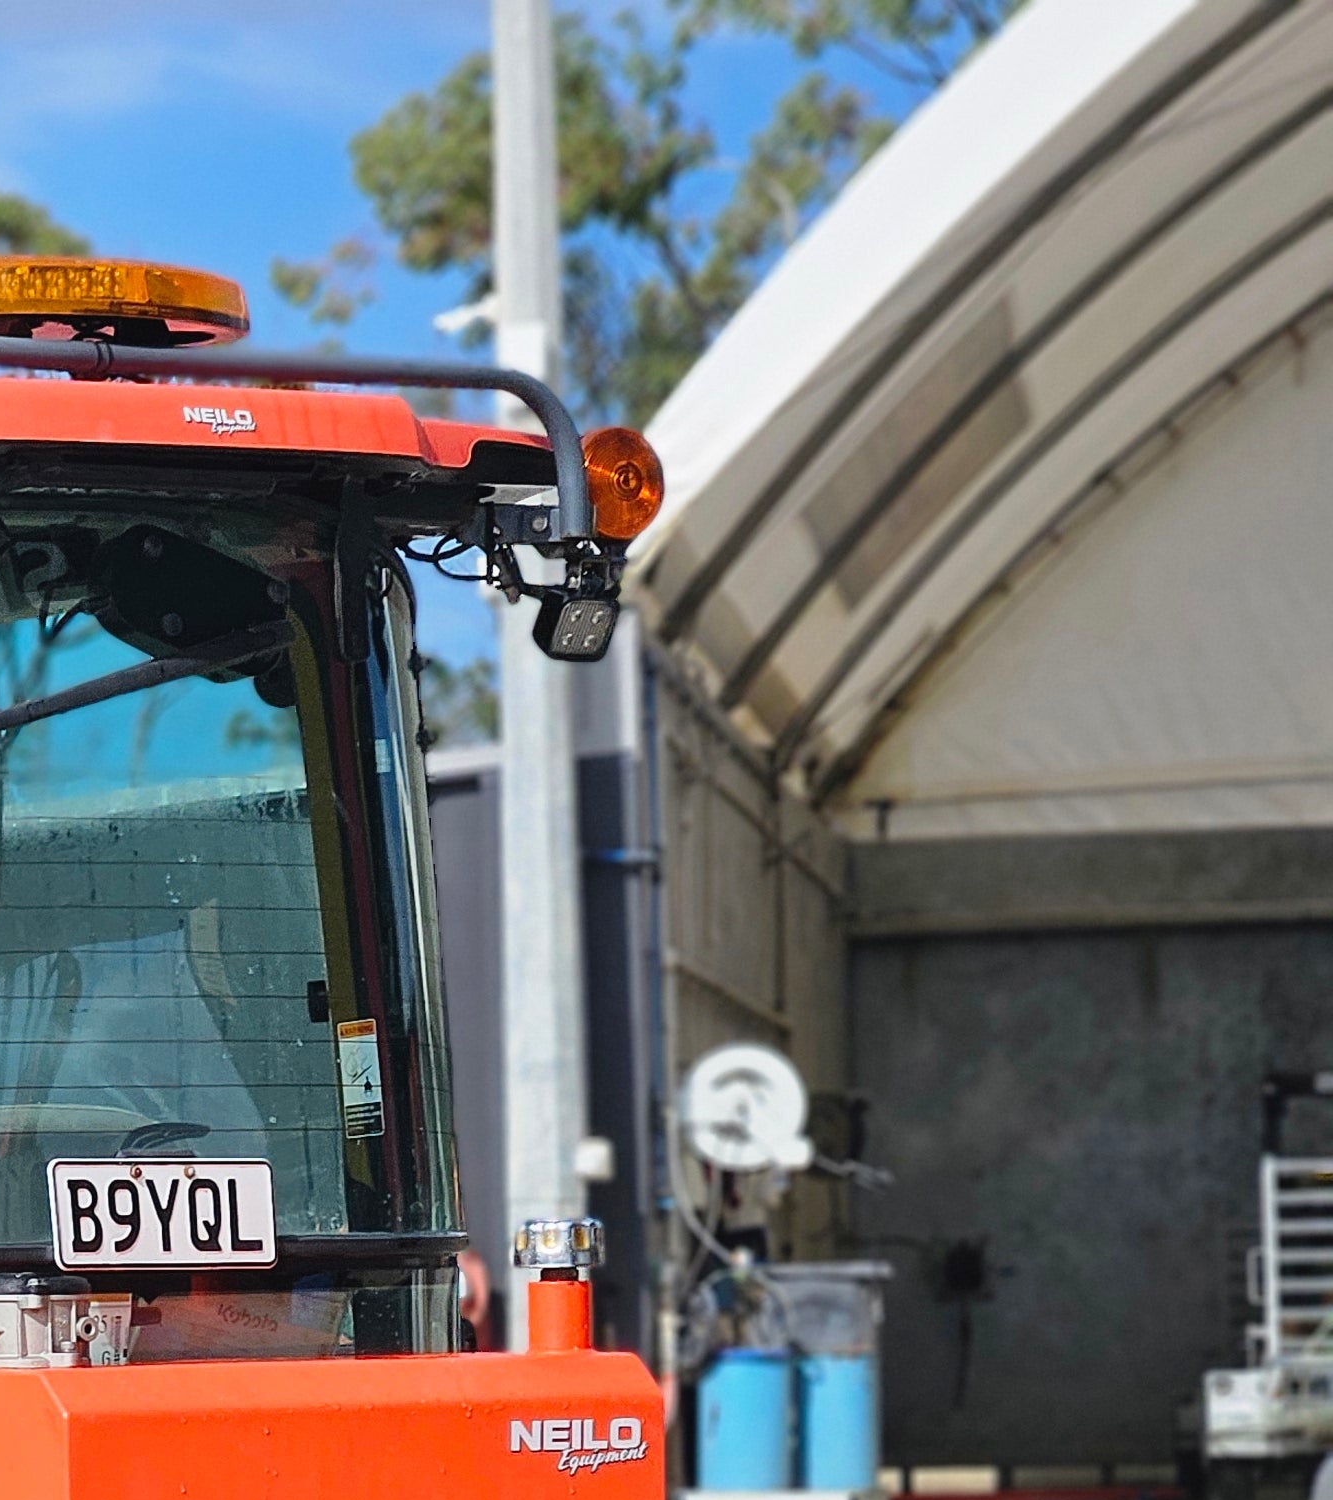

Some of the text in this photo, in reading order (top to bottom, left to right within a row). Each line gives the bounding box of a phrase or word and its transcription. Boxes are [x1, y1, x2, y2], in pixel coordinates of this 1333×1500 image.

[182, 406, 253, 425] NEILO
[67, 1178, 264, 1253] B9YQL
[510, 1417, 642, 1452] NEILO
[556, 1441, 650, 1476] Equipment
